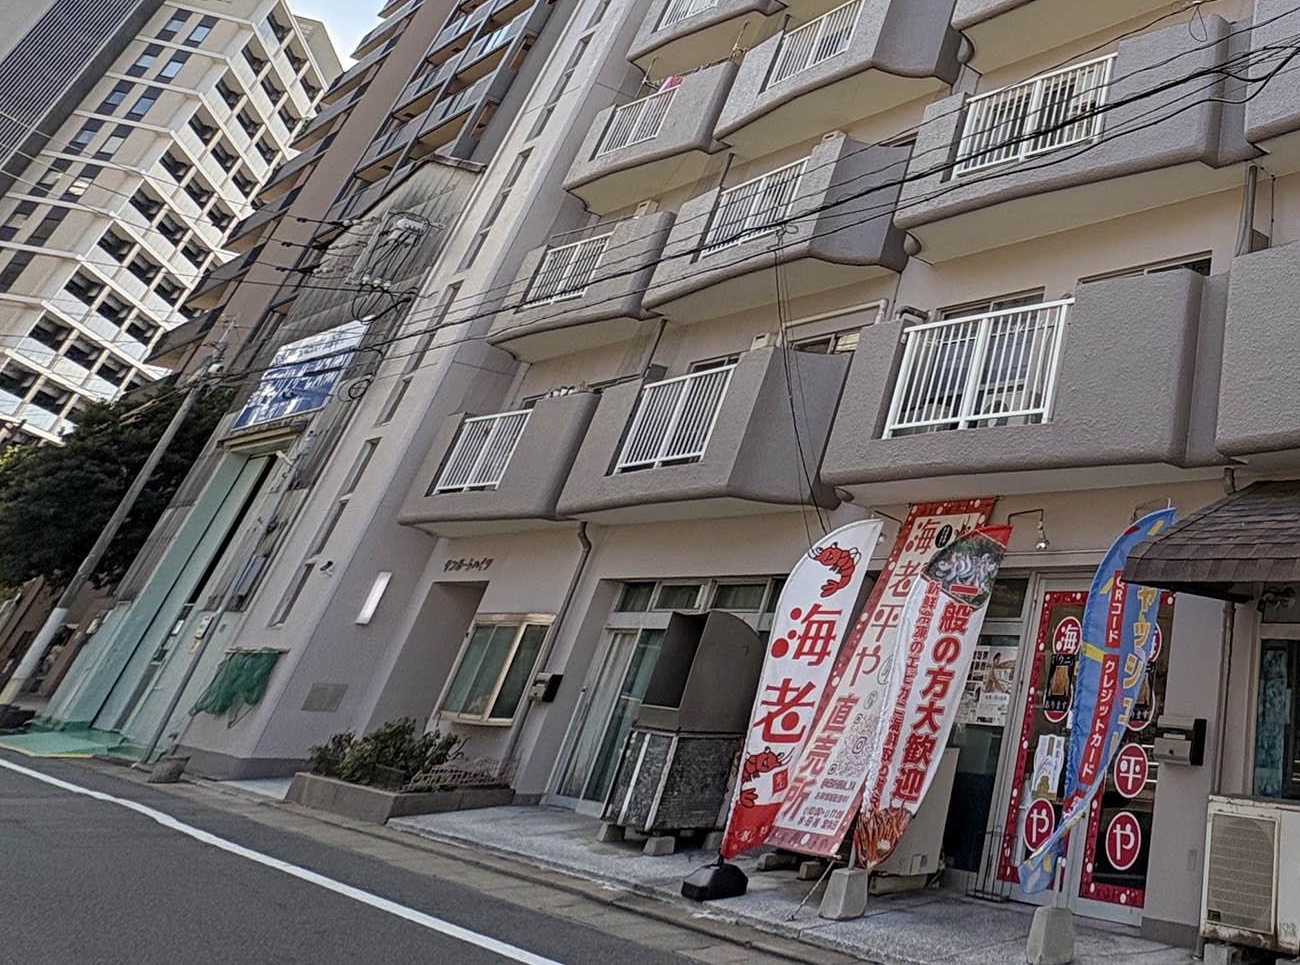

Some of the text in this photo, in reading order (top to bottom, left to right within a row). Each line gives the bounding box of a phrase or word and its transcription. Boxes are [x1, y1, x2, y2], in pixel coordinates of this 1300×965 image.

[753, 603, 843, 743] 海老
[892, 584, 979, 803] 一般の方大歓迎
[1082, 660, 1115, 777] クレジットカード
[1120, 756, 1143, 790] 平
[1113, 824, 1135, 860] や
